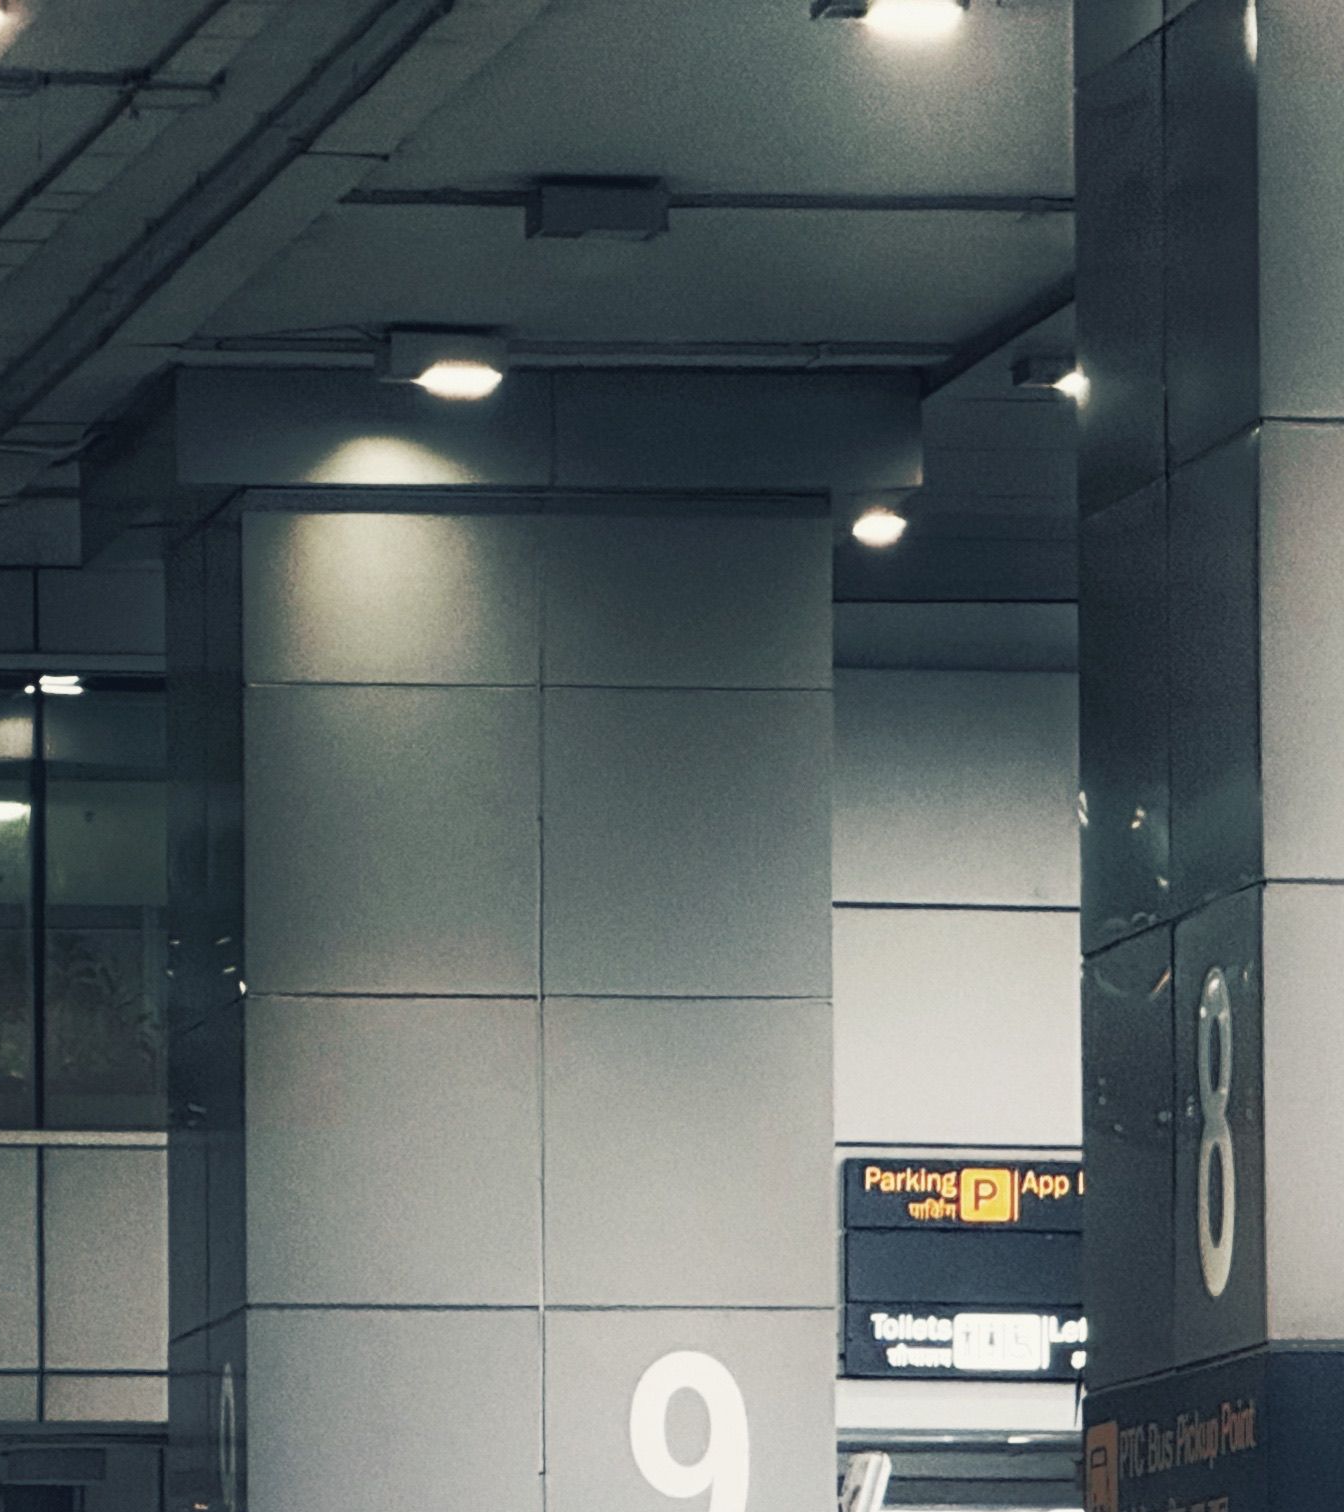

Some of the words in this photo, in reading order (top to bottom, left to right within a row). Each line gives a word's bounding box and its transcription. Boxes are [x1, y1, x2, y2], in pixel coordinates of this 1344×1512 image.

[1198, 966, 1235, 1297] 8
[864, 1166, 957, 1198] Parking
[1021, 1171, 1069, 1199] App
[870, 1313, 954, 1342] Toilets
